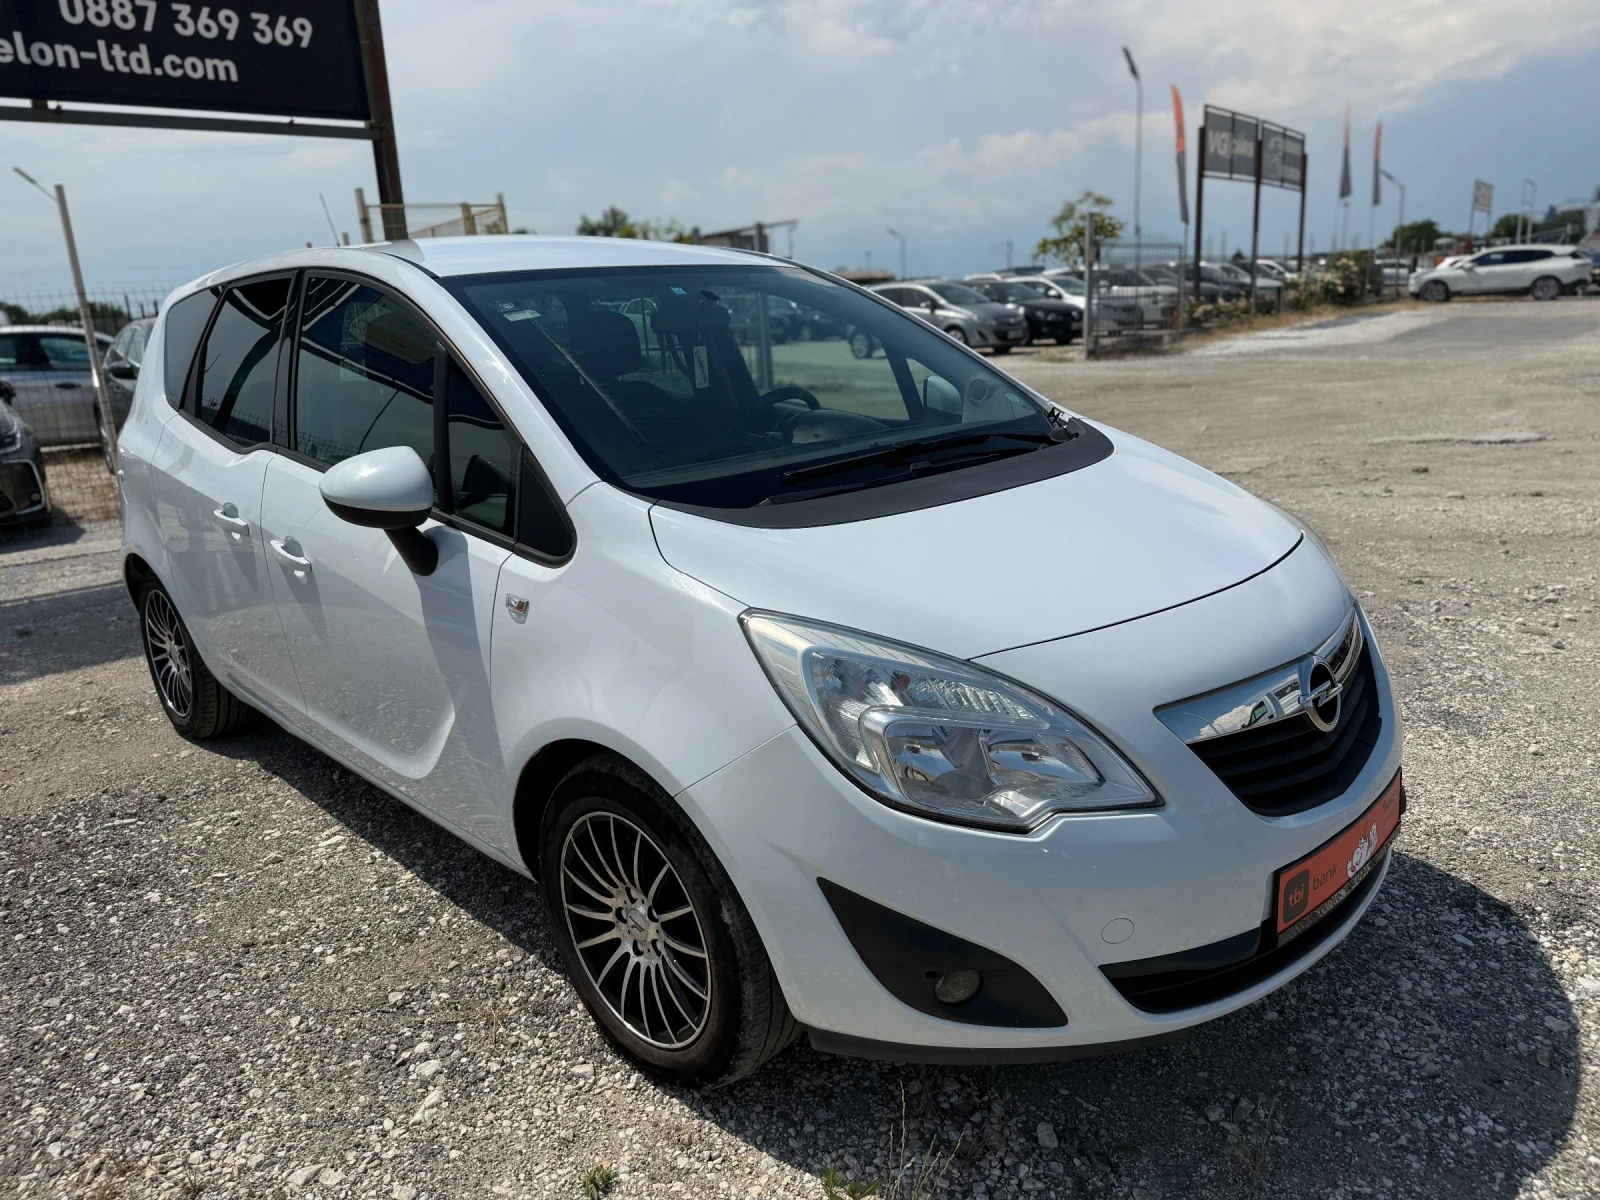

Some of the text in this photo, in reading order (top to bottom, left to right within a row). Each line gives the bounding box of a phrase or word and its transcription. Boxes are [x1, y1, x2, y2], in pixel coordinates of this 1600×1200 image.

[58, 0, 313, 48] 0887 369 369
[0, 30, 239, 82] elon-ltd.com
[1288, 883, 1305, 908] tbi
[1312, 861, 1338, 892] bank
